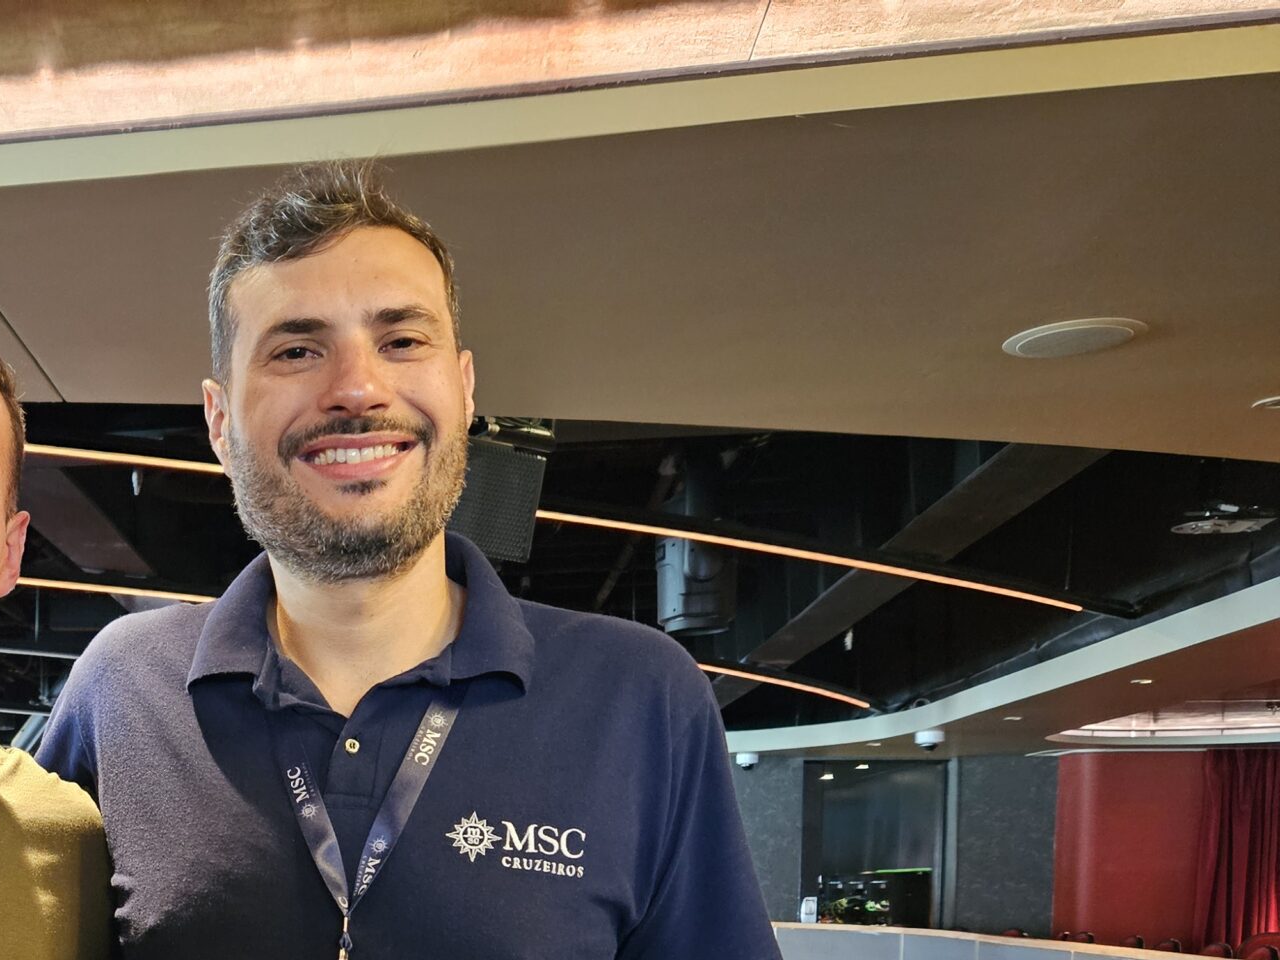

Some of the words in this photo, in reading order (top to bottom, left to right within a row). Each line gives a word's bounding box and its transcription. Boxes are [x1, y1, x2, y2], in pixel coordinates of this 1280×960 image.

[414, 728, 441, 766] MSC
[286, 766, 310, 804] MSC
[501, 820, 587, 859] MSC
[501, 856, 585, 879] CRUZEIROS
